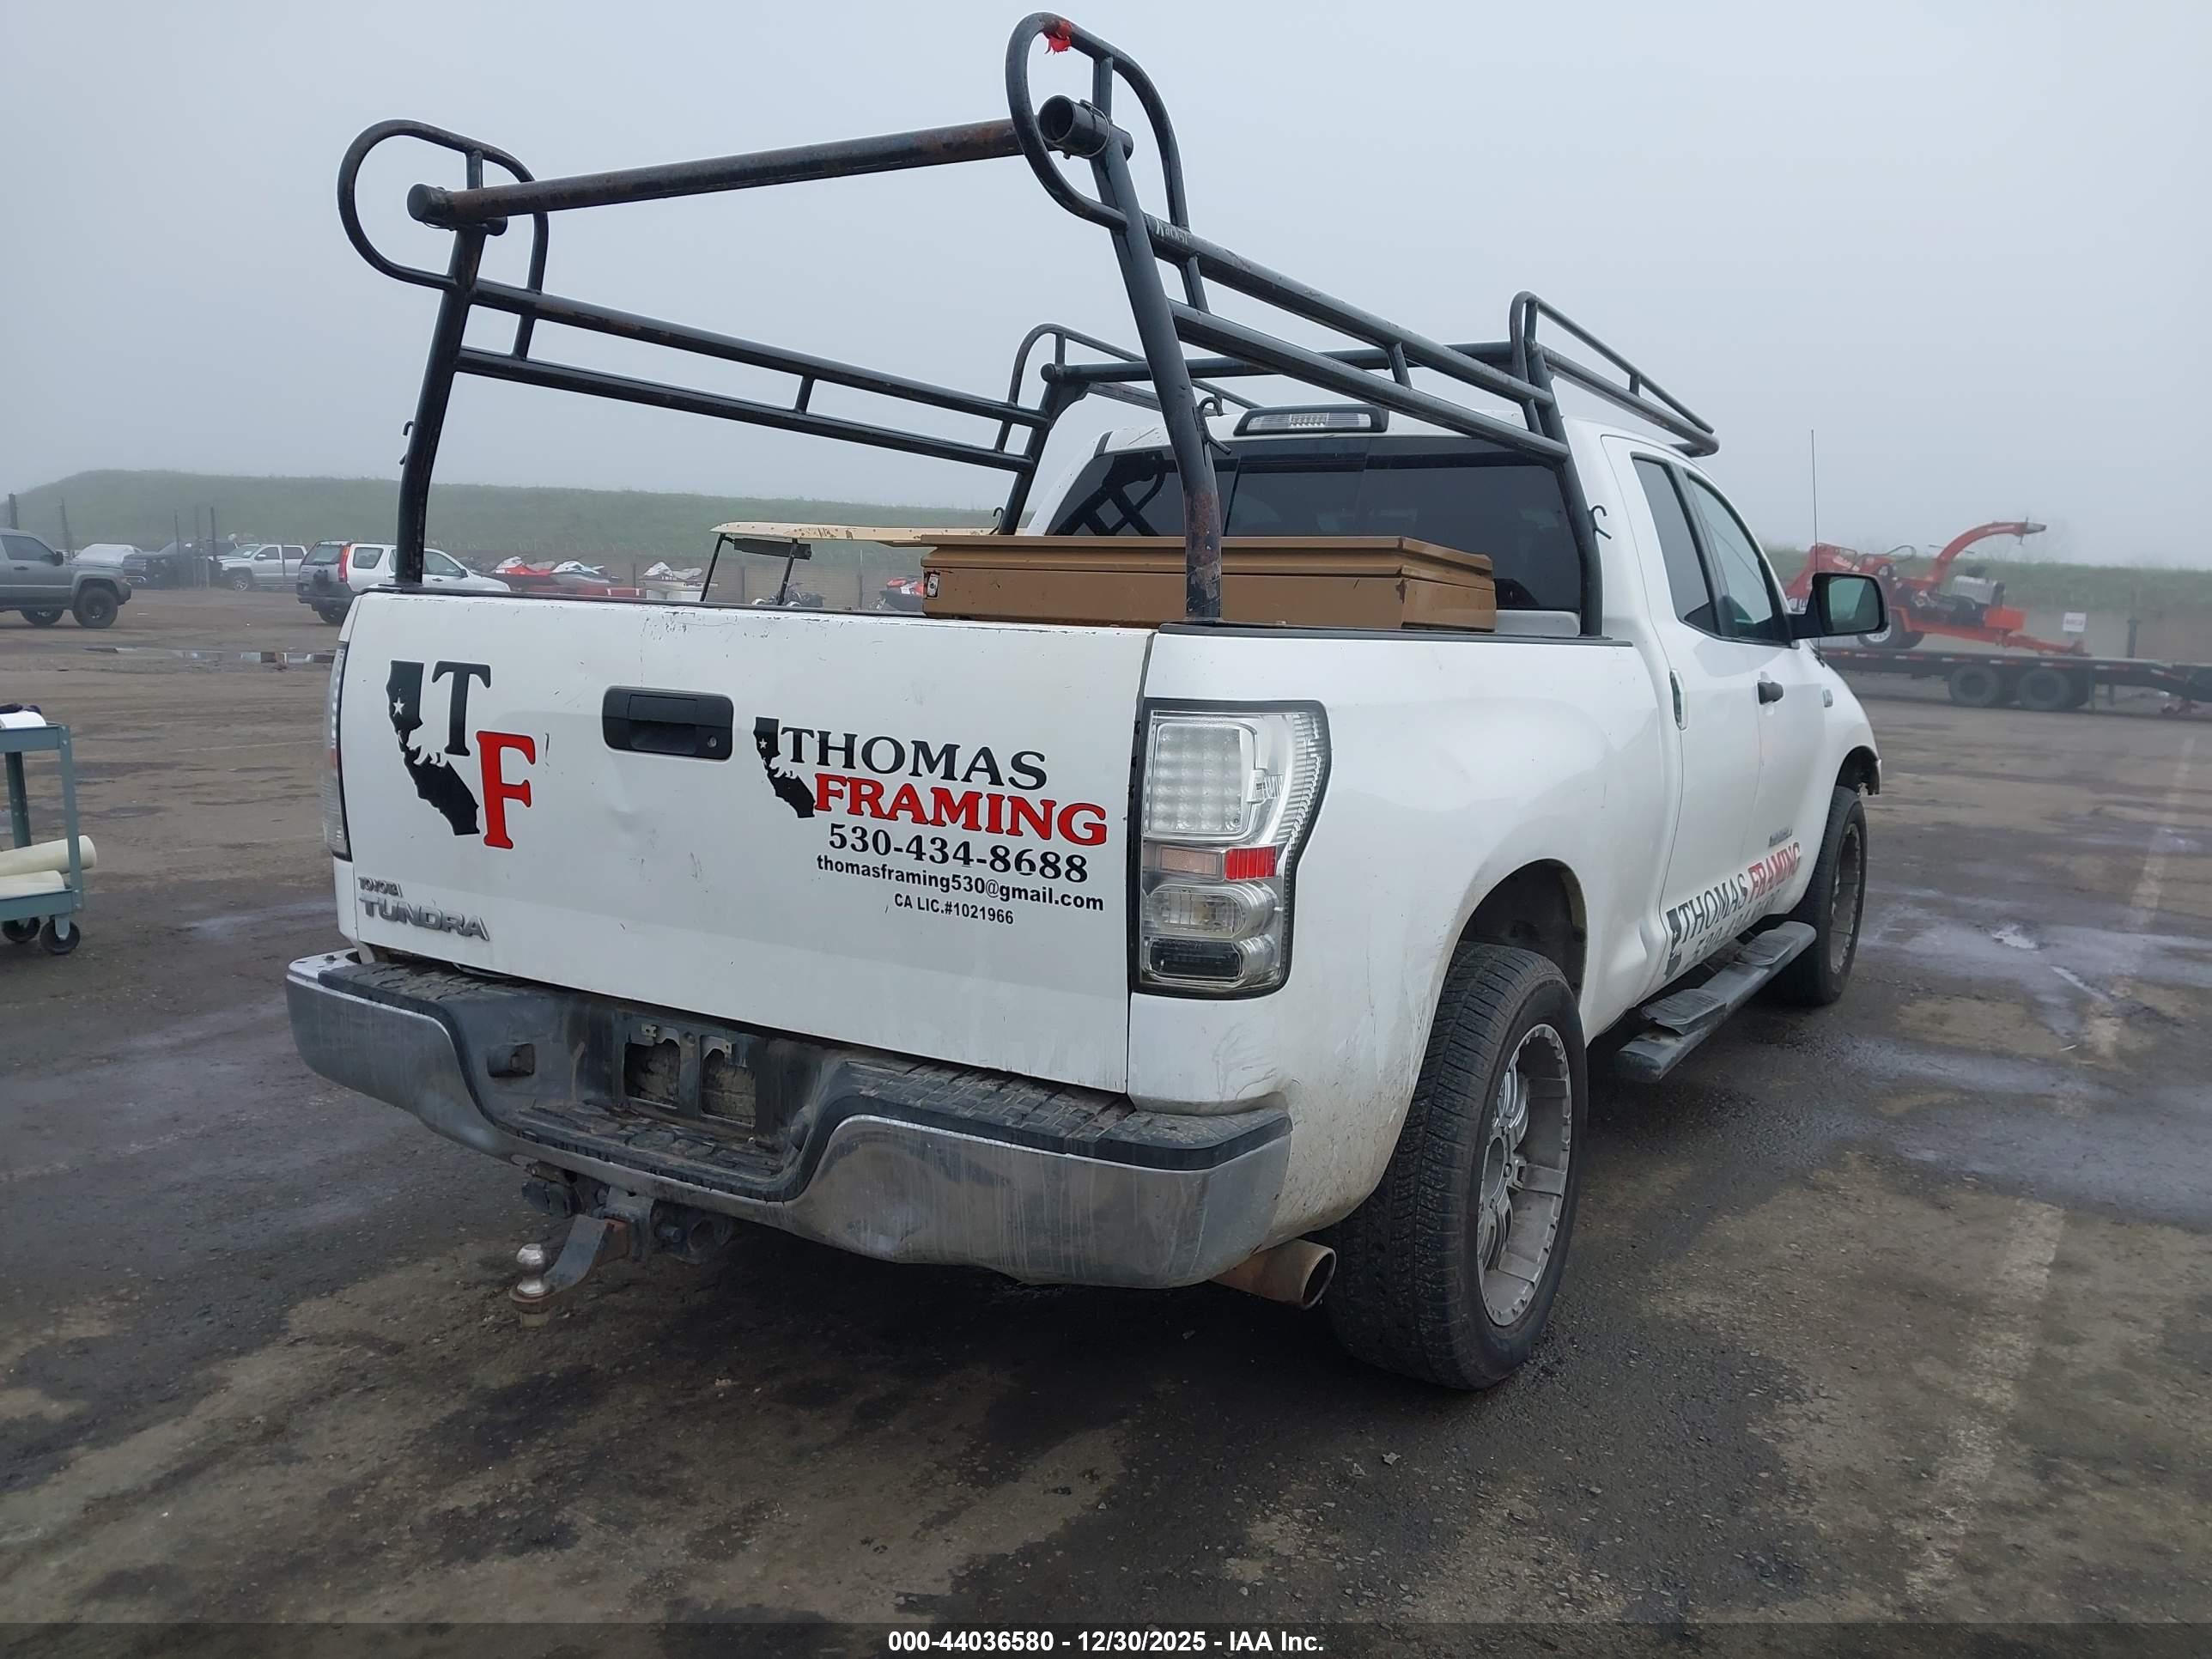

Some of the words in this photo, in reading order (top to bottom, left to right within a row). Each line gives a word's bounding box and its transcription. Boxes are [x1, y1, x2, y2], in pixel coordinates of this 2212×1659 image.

[431, 660, 491, 757] T
[781, 726, 1048, 790] THOMAS
[476, 731, 537, 849] F
[814, 773, 1108, 846] FRAMING
[817, 854, 1104, 911] thomasframing530@gmail.com
[829, 823, 1088, 883] 530-434-8688
[358, 877, 403, 897] TOYOTA
[894, 893, 913, 909] CA
[917, 896, 1014, 925] LIC.#1021966
[1679, 873, 1747, 944] THOMAS
[1748, 842, 1801, 902] FRAMING
[359, 895, 490, 942] TUNDRA
